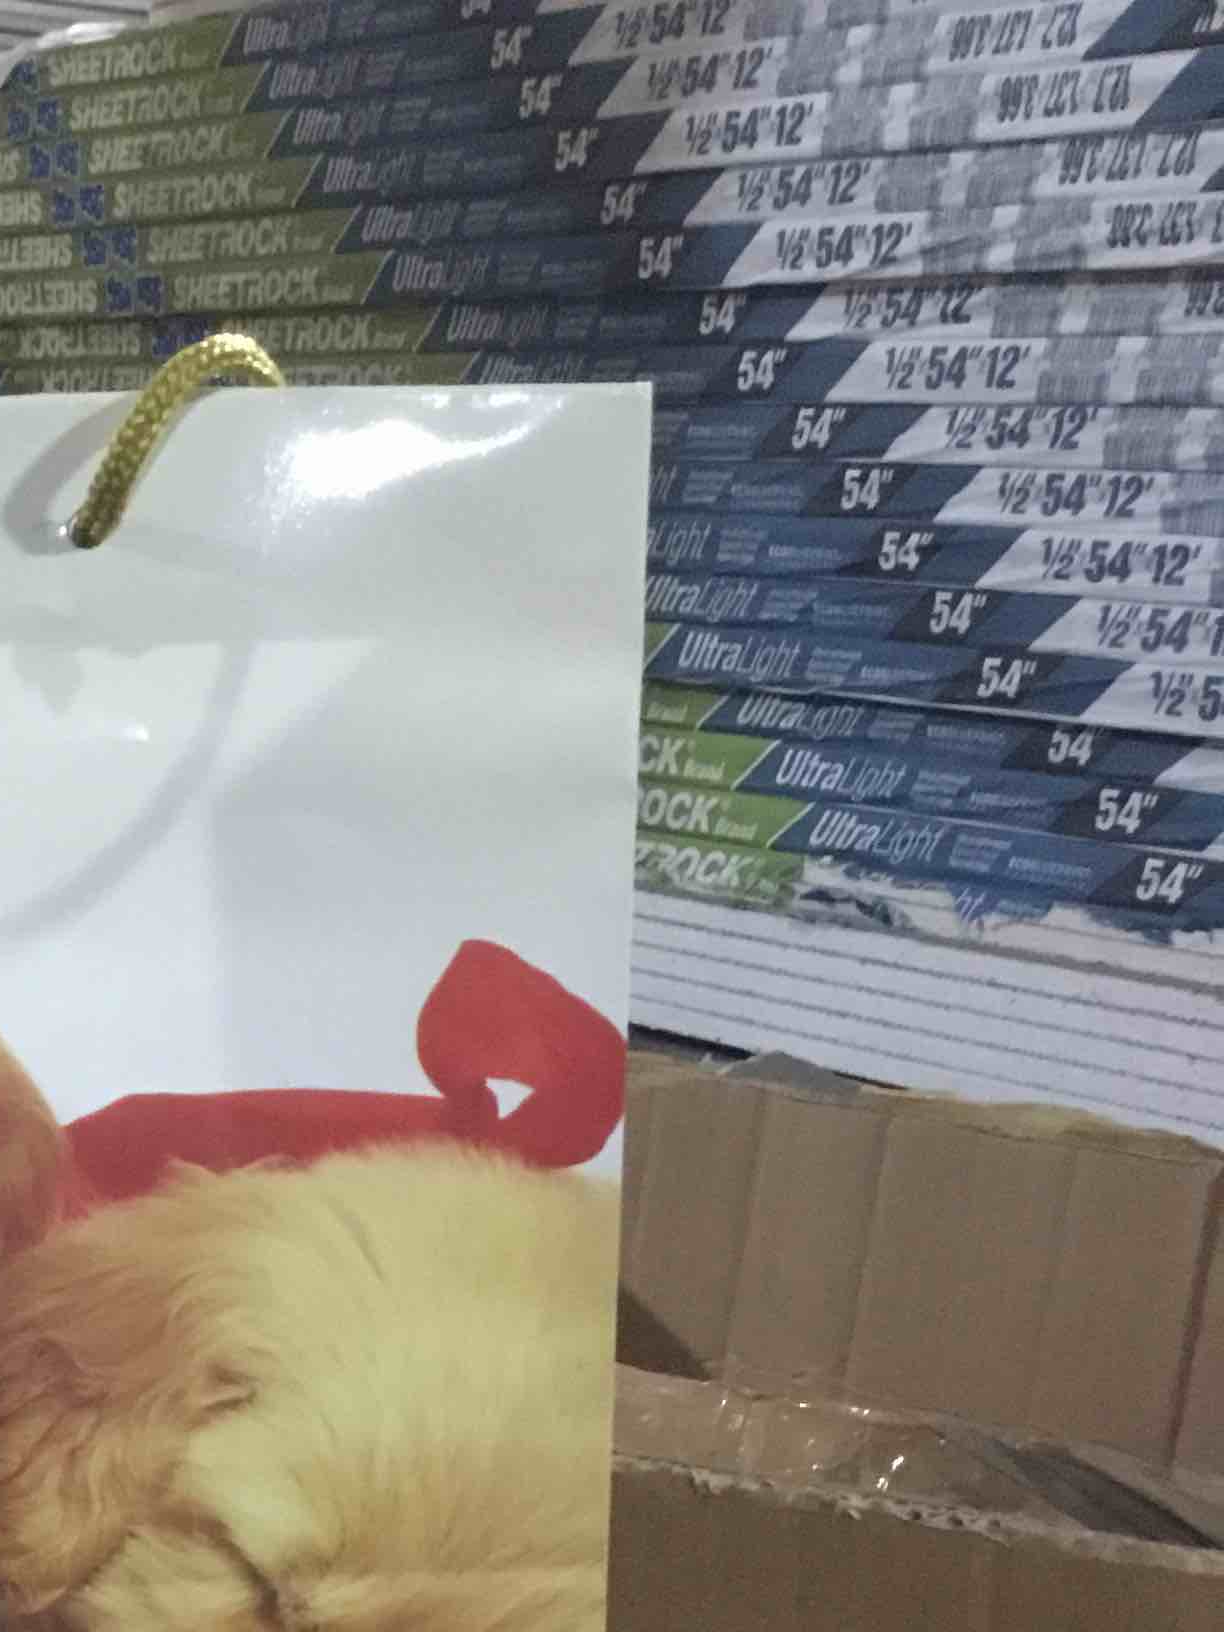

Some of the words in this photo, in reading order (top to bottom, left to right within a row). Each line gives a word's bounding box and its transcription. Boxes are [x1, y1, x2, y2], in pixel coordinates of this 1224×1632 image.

[638, 235, 685, 280] 54"
[737, 348, 788, 392] 54"
[791, 407, 847, 450] 54"
[840, 468, 895, 511] 54"
[877, 530, 935, 572] 54"
[928, 590, 989, 636] 54"
[677, 630, 802, 683] UltraLight
[976, 656, 1038, 700] 54"
[775, 747, 908, 801] UltraLight
[1094, 787, 1160, 834] 54"
[809, 809, 946, 865] UltraLight
[1135, 856, 1205, 905] 54"
